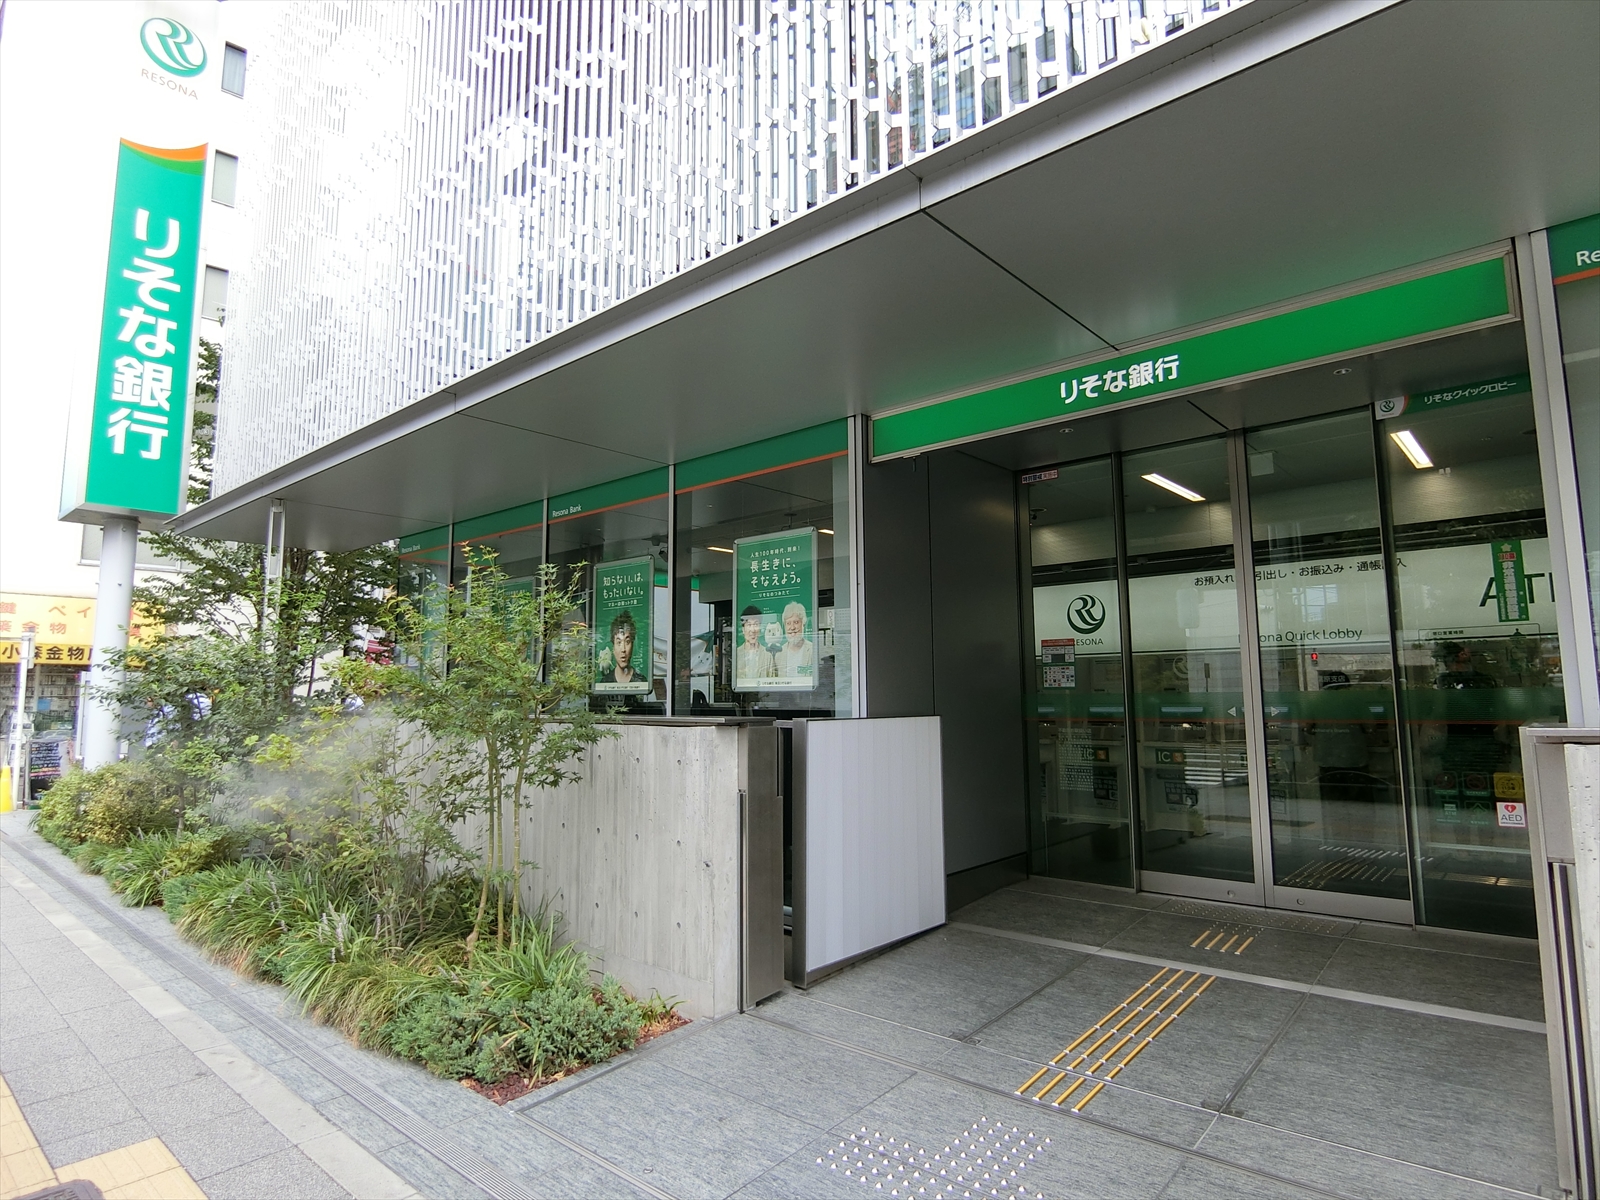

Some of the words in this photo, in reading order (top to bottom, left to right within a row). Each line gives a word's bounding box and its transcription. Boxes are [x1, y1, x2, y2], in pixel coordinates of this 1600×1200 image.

[141, 68, 199, 100] RESONA
[107, 207, 181, 460] りそな銀行
[1060, 354, 1180, 405] りそな銀行
[1424, 381, 1517, 405] りそなクイックロビー
[552, 508, 569, 518] Resona
[569, 504, 582, 514] Bank
[750, 557, 796, 573] 長生きに、
[751, 571, 801, 588] そなえよう。
[603, 586, 644, 599] もったいない。
[1074, 637, 1104, 646] ESONA
[1285, 629, 1320, 642] Quick
[1323, 628, 1363, 641] Lobby
[1158, 751, 1171, 762] IC
[1500, 814, 1523, 822] AED
